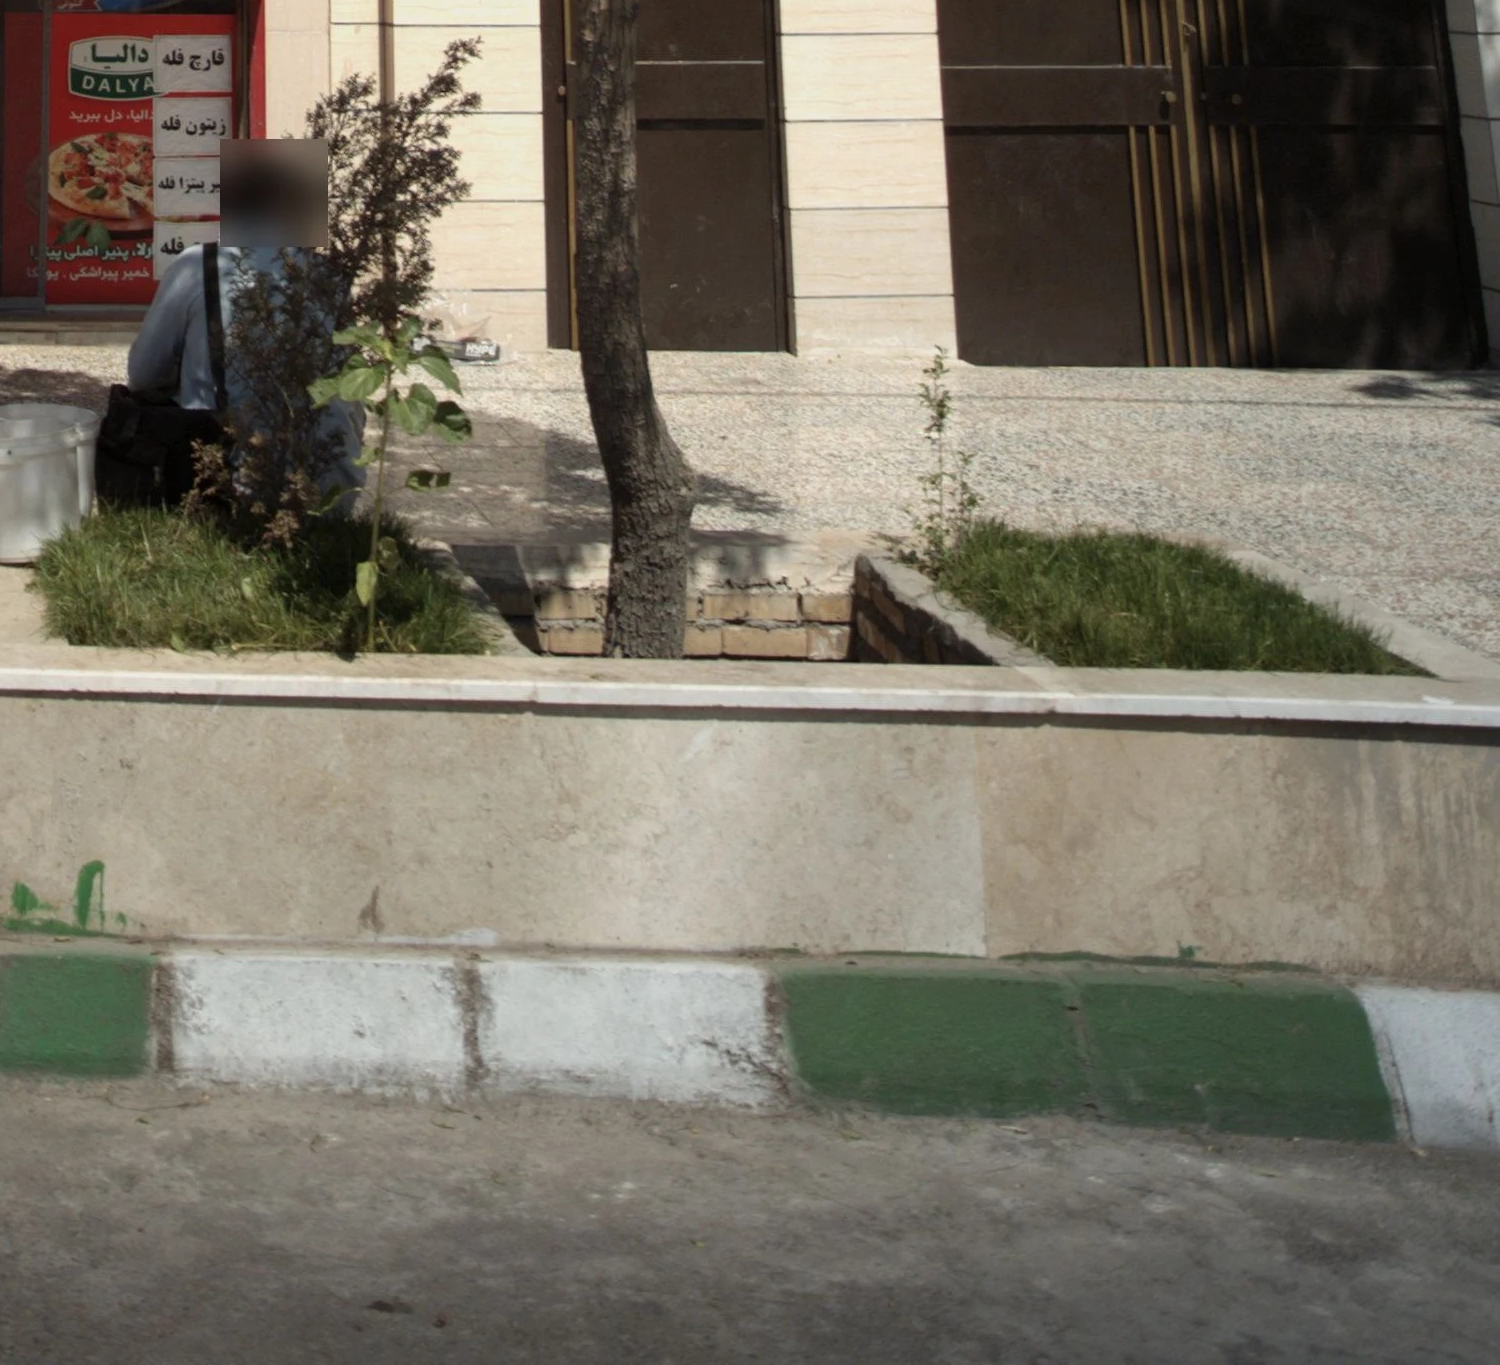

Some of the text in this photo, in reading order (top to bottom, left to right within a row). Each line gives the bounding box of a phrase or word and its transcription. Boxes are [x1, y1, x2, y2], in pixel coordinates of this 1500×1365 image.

[90, 42, 150, 70] دالیا
[162, 47, 225, 71] قارچ فله
[68, 110, 101, 124] ببرید
[104, 108, 124, 124] دل
[160, 115, 227, 136] زیتون فله
[158, 175, 176, 190] فله
[179, 176, 205, 195] پیتزا
[64, 244, 98, 261] اصلی
[102, 247, 130, 262] پنیر
[160, 236, 185, 256] فله
[68, 264, 119, 282] پیراشکی
[120, 266, 150, 281] خمیر
